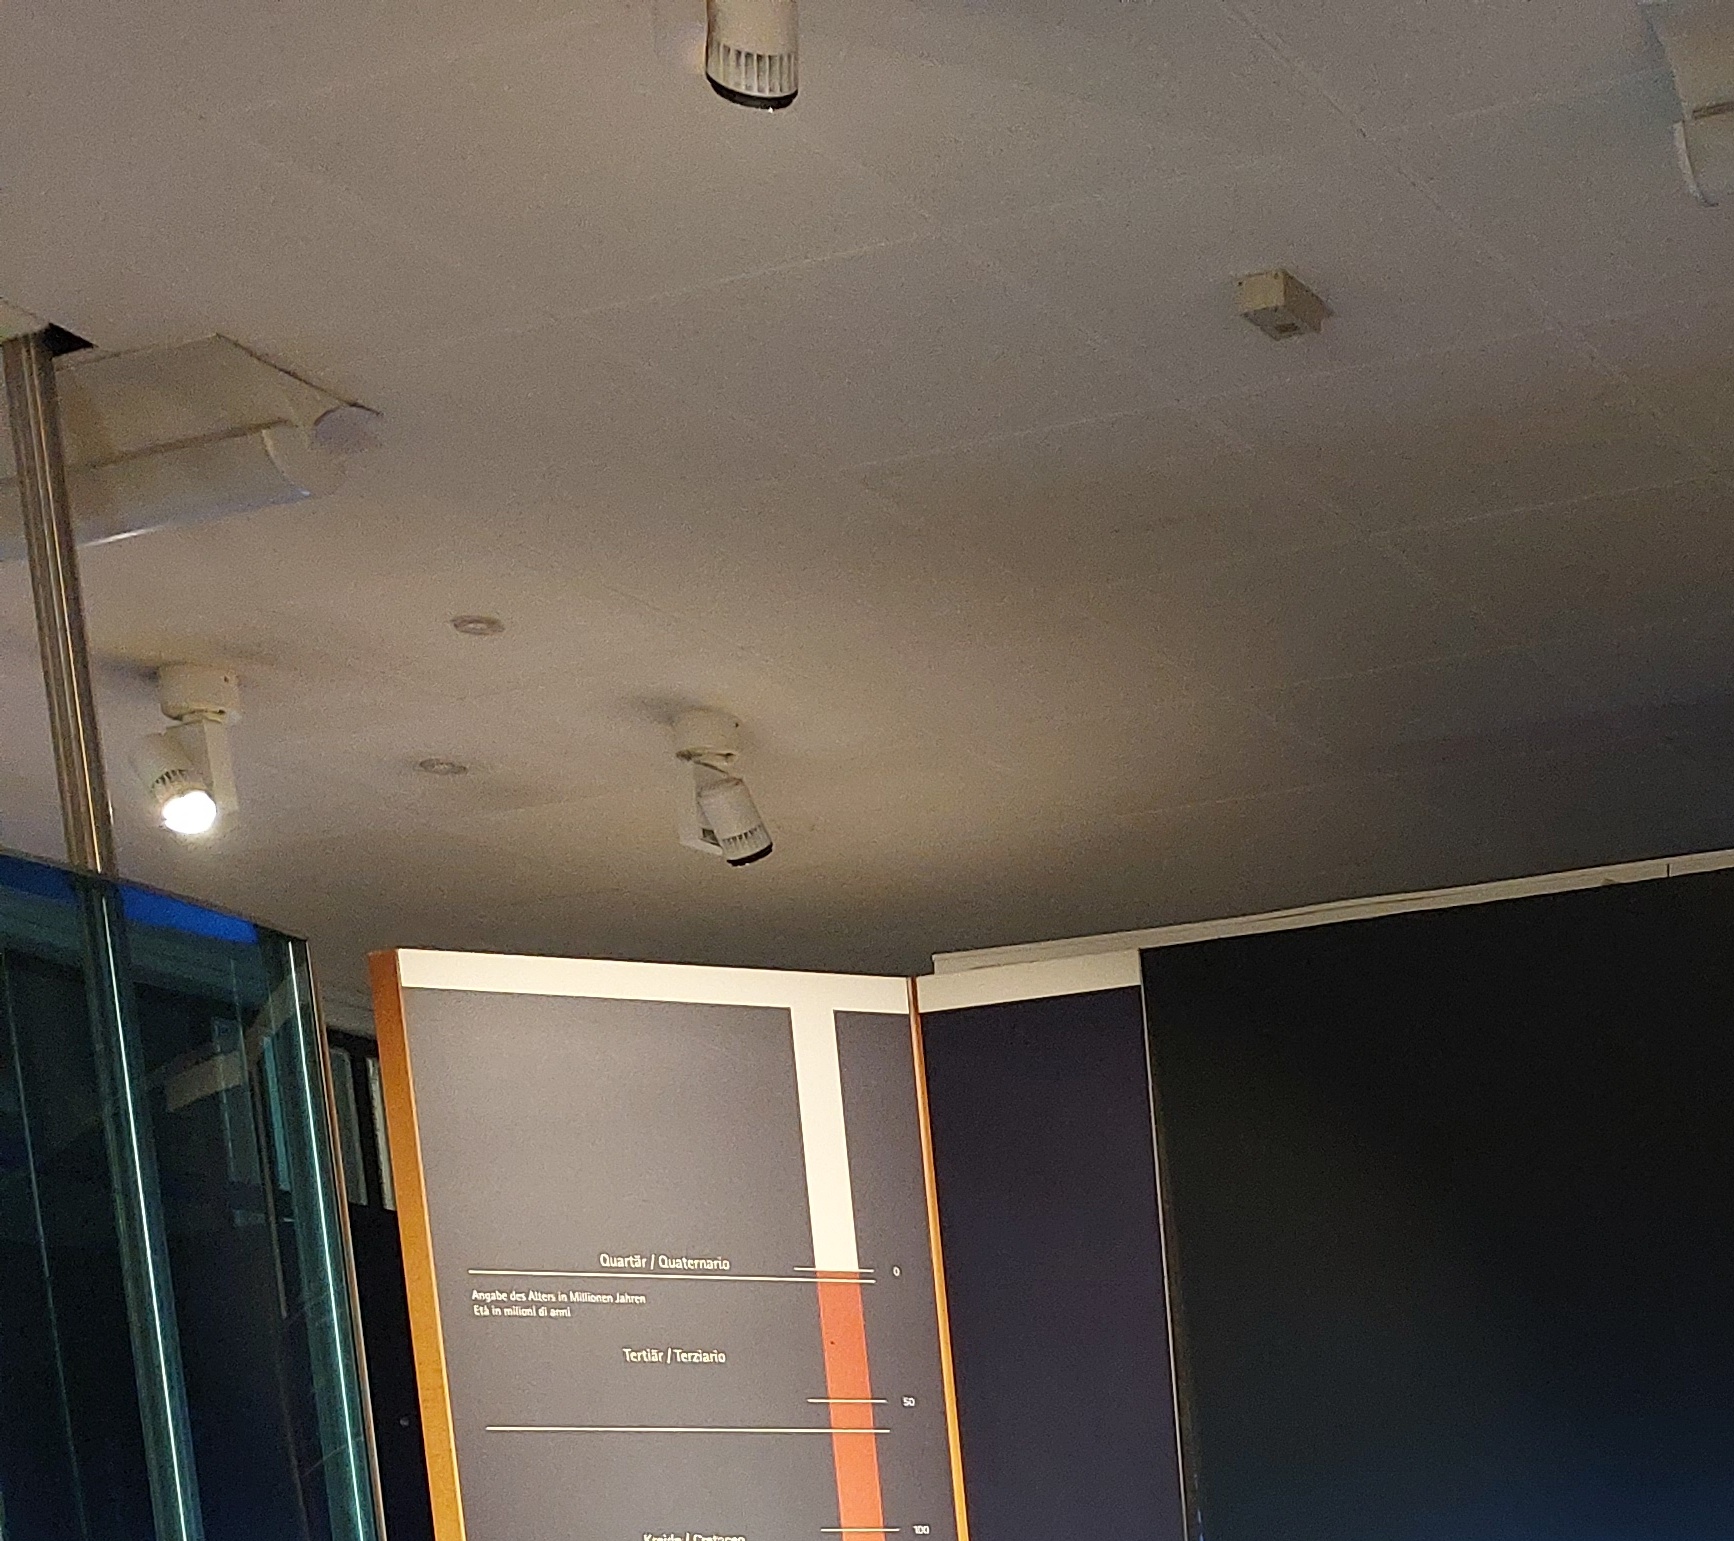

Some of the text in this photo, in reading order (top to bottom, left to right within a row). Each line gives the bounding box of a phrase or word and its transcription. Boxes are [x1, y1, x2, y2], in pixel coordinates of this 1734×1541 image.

[600, 1253, 646, 1269] Quartär
[658, 1255, 731, 1270] Quaternario
[472, 1289, 646, 1305] Angabe des Alters in Millionen Jahren
[491, 1304, 502, 1317] in
[503, 1305, 536, 1317] milioni
[622, 1348, 664, 1363] Tertiär
[672, 1348, 726, 1364] Terziario
[903, 1396, 916, 1407] 50
[912, 1525, 930, 1535] 100
